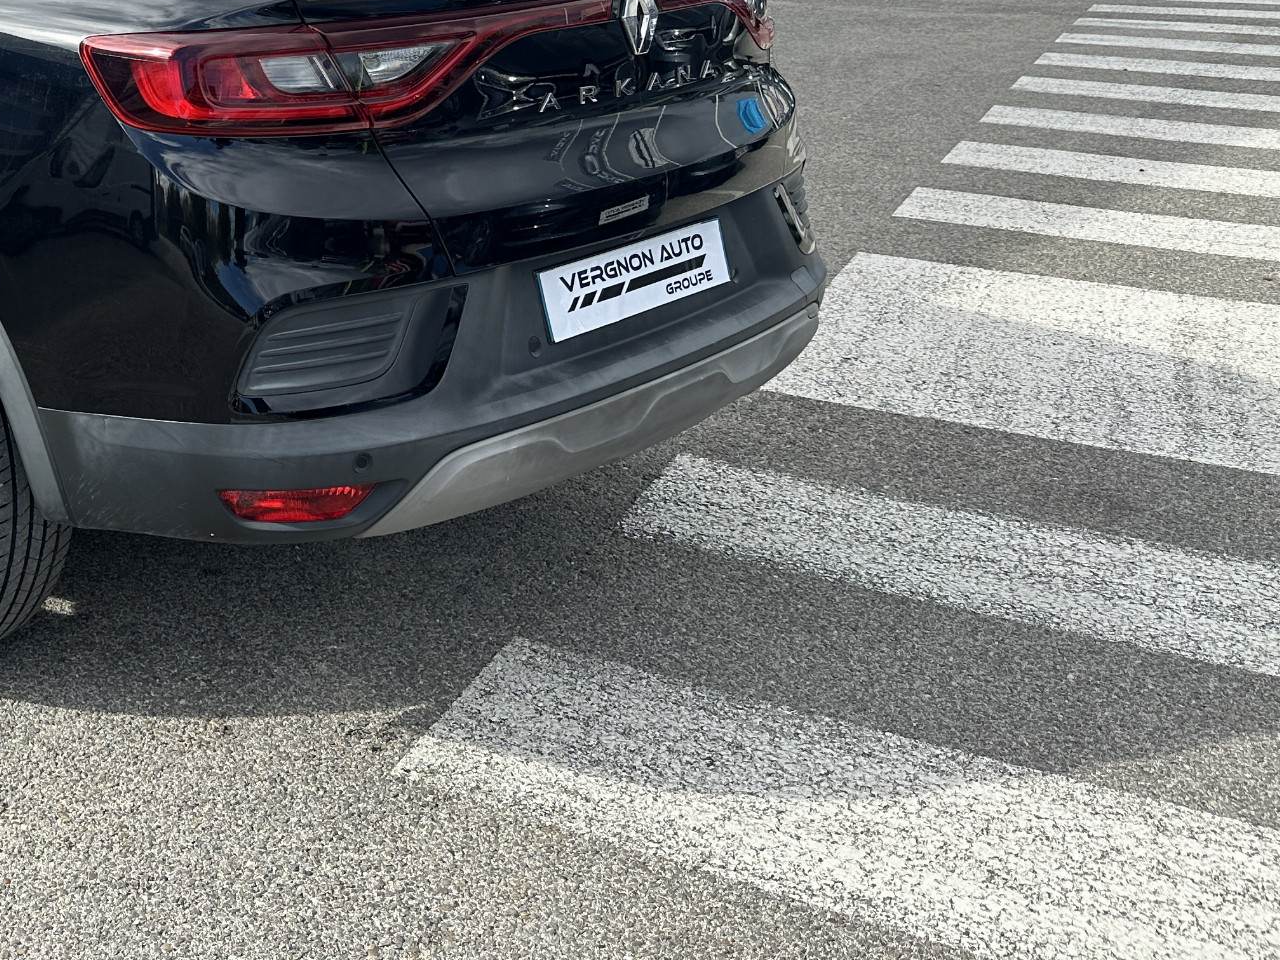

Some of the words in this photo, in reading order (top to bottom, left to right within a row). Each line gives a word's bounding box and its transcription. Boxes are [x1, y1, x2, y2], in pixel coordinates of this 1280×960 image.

[538, 59, 719, 113] ARKANA
[559, 253, 655, 293] VERGNON
[660, 233, 704, 262] AUTO
[665, 269, 714, 296] GROUPE
